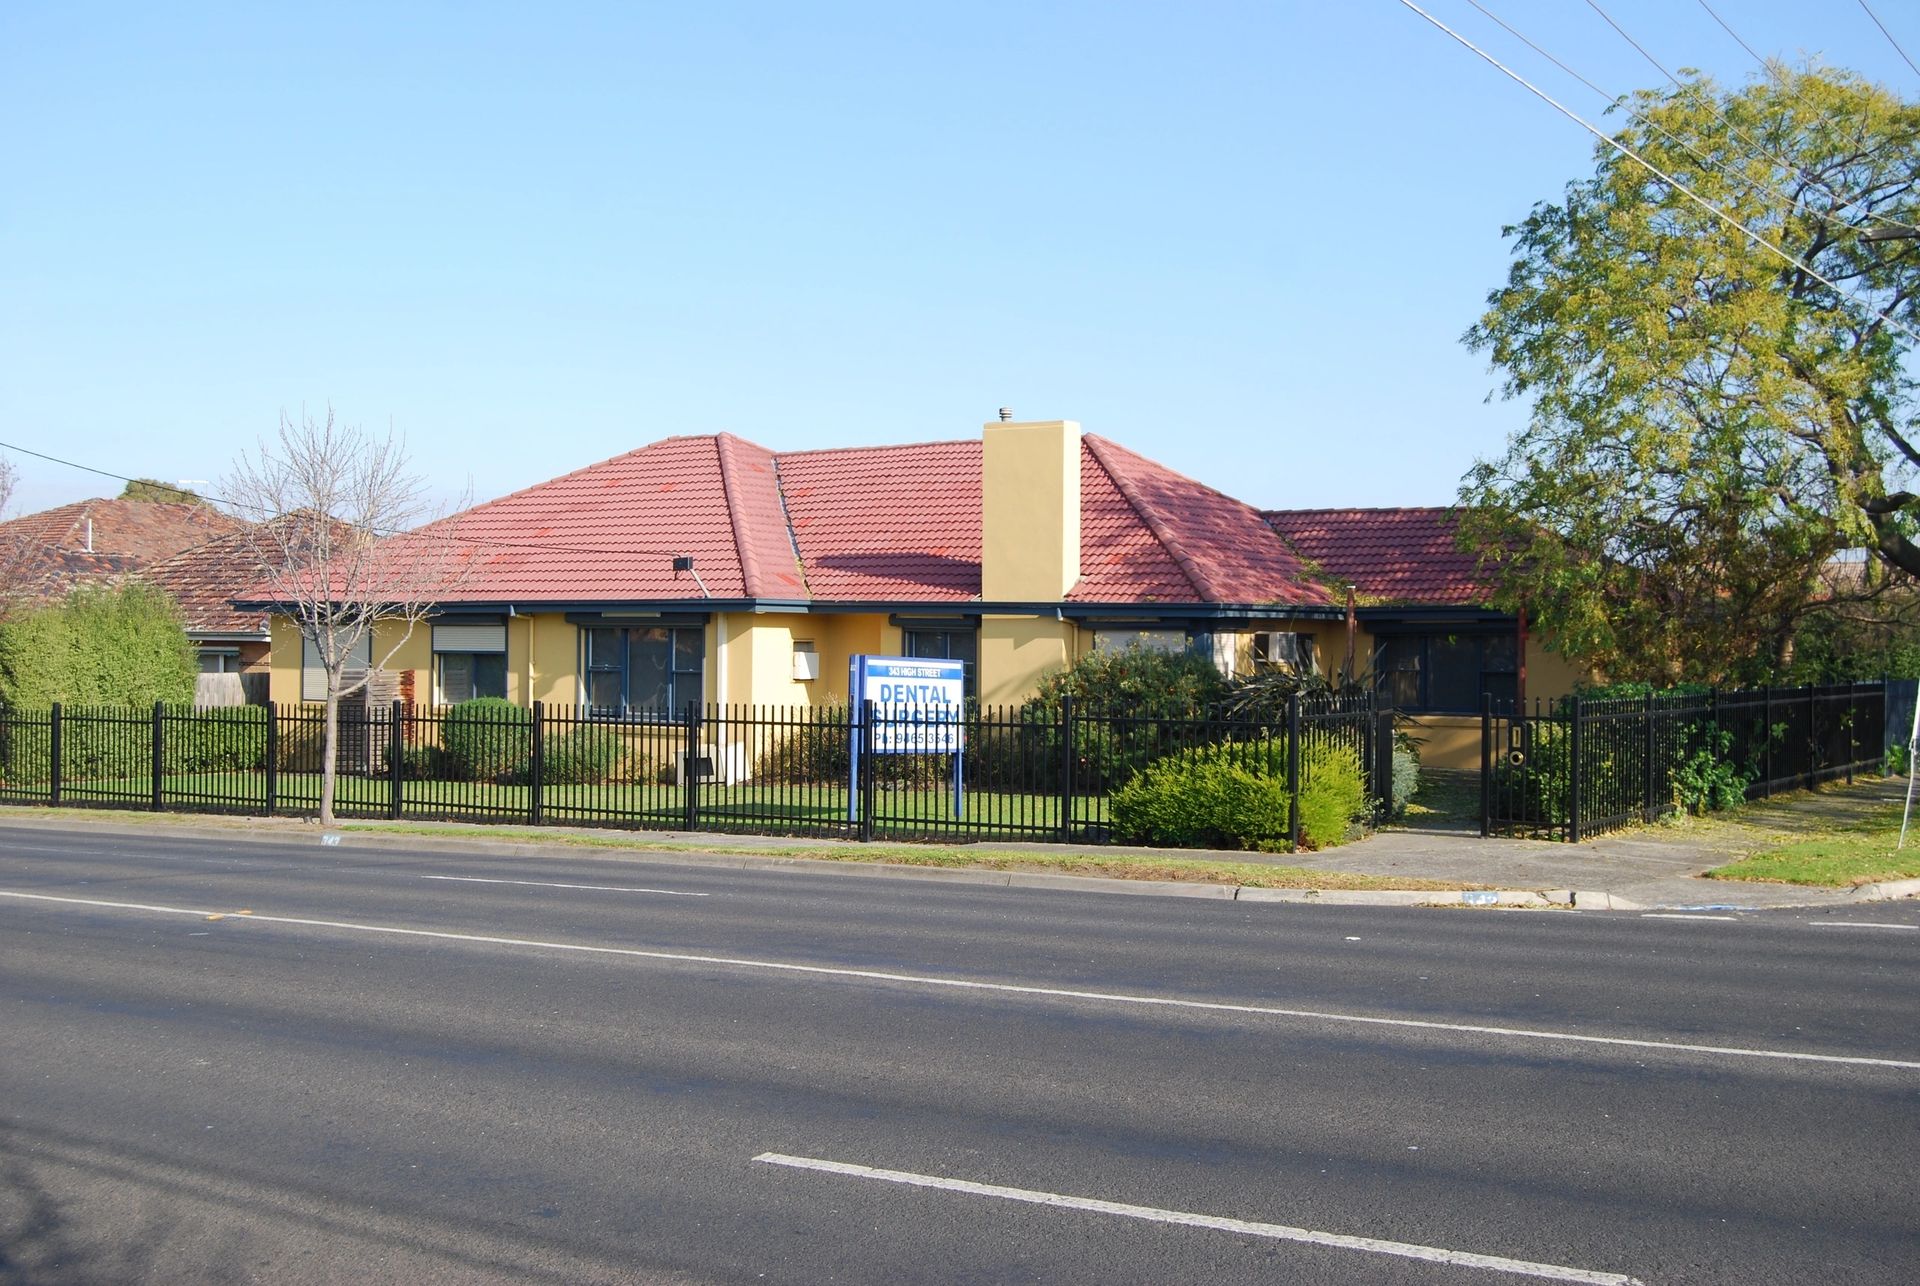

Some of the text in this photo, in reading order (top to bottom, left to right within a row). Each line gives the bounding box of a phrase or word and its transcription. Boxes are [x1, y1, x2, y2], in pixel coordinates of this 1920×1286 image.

[888, 666, 941, 678] 343 HIGH STREET
[880, 683, 952, 704] DENTAL
